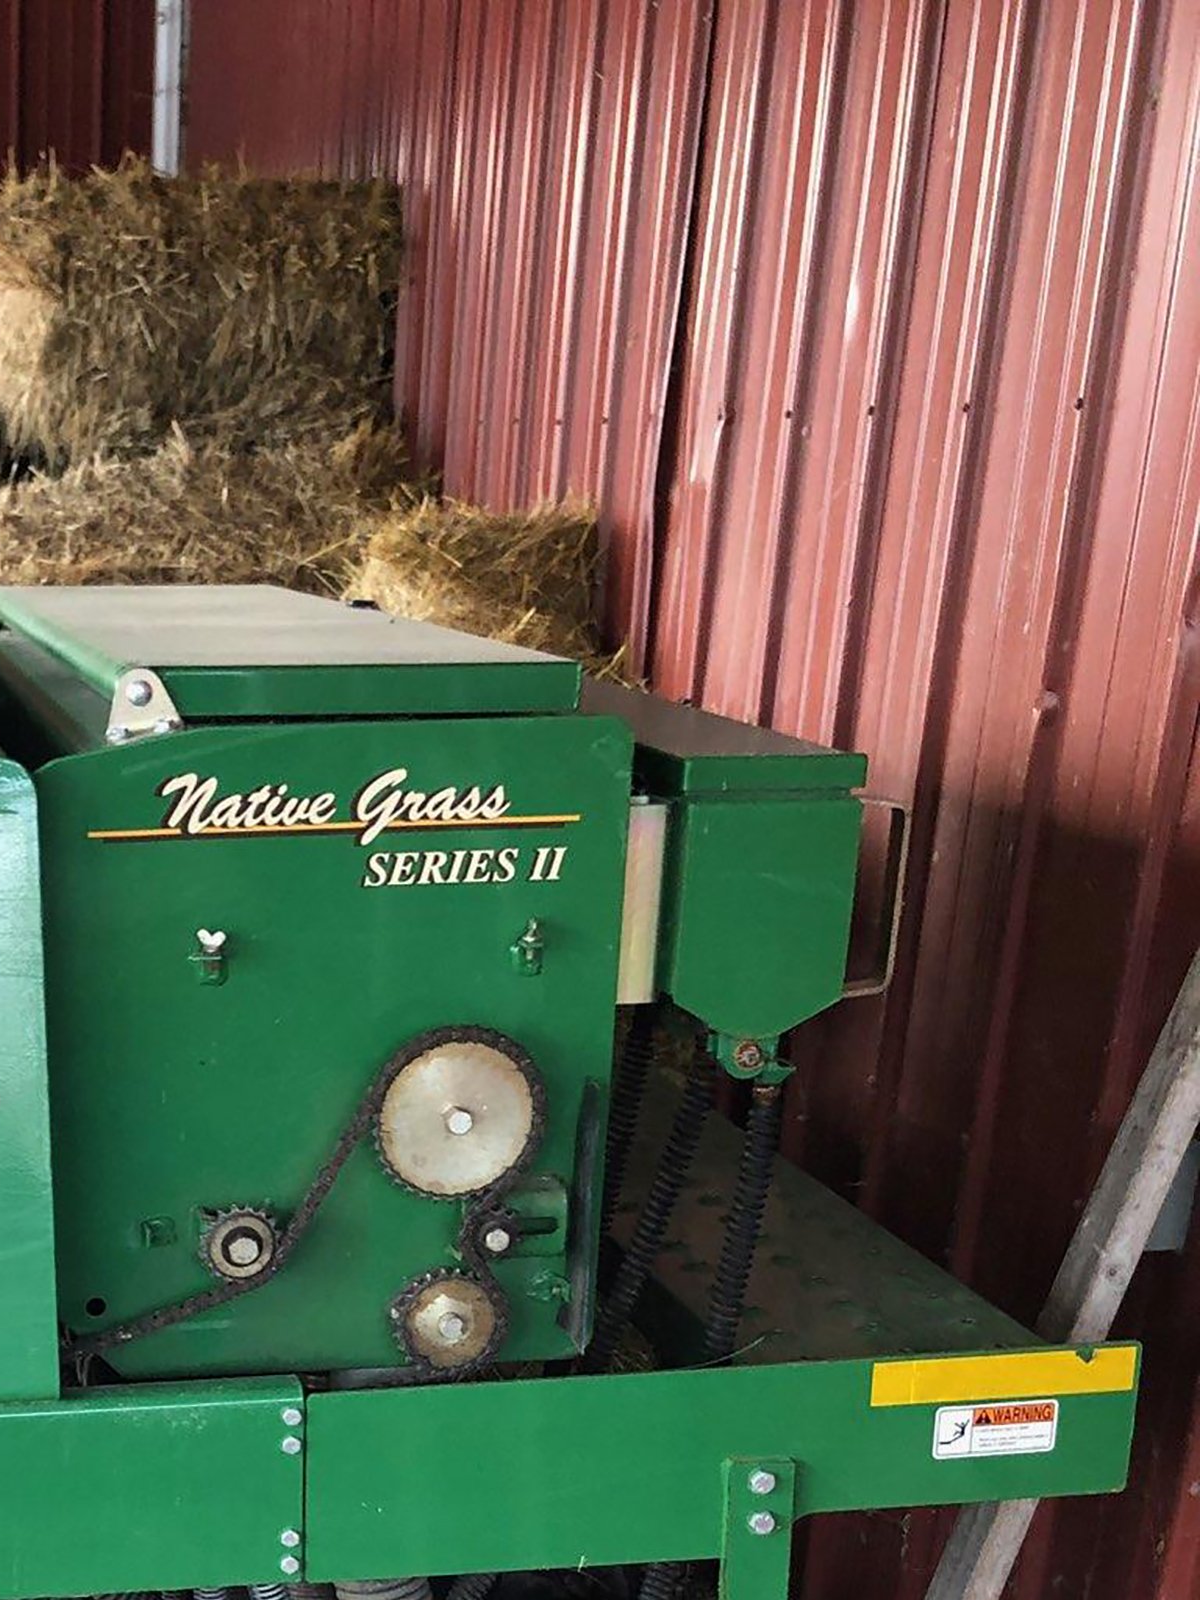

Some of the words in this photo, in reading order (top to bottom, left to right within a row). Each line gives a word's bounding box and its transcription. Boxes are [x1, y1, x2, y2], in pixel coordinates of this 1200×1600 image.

[158, 771, 336, 835] Native
[353, 767, 512, 846] Grass
[362, 847, 519, 888] SERIES
[528, 846, 568, 882] II
[994, 1405, 1051, 1422] WARNING
